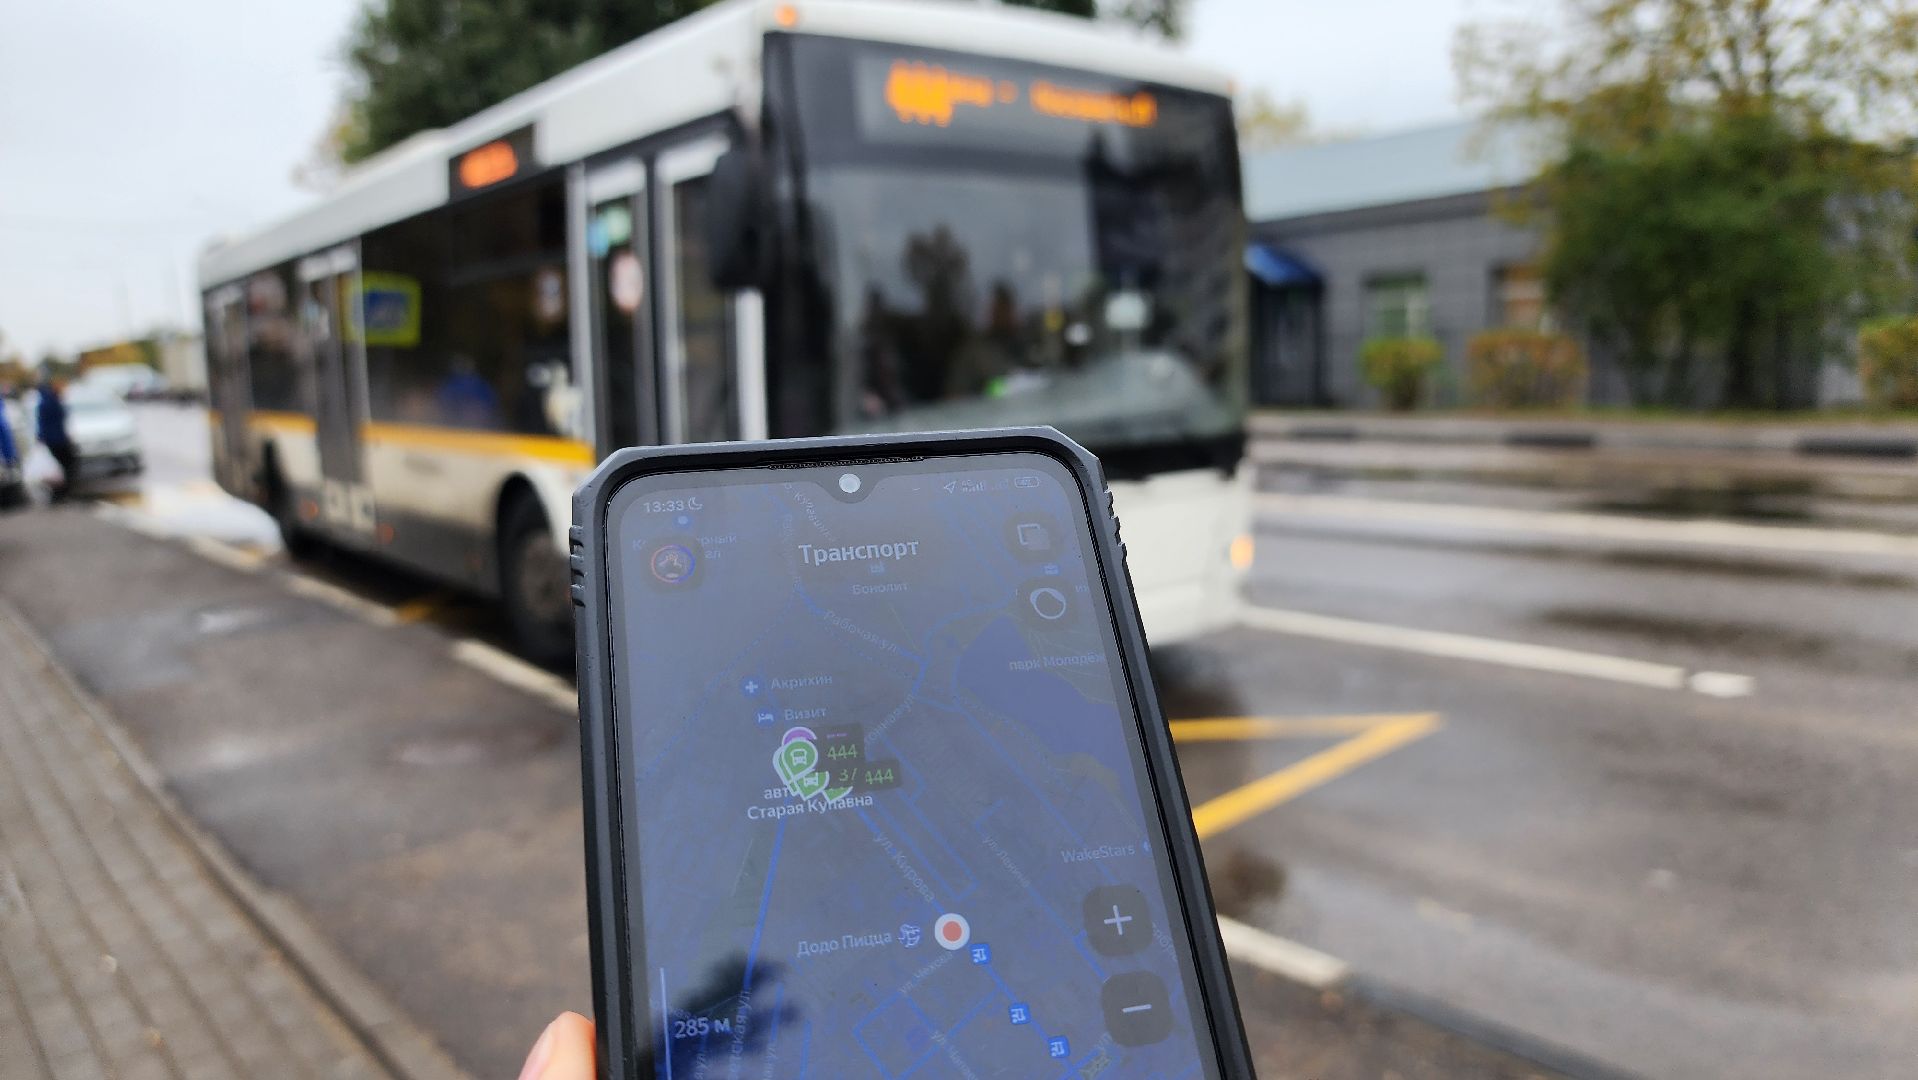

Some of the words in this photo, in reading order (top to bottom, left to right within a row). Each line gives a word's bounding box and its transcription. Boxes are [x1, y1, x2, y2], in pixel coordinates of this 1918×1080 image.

[643, 499, 685, 513] 13:33
[798, 540, 919, 567] Транспорт
[852, 582, 909, 596] Бонолит
[824, 608, 881, 646] Рабочая
[770, 674, 833, 690] Акрихин
[784, 706, 827, 721] Визит
[827, 743, 858, 760] 444
[865, 767, 894, 785] 444
[747, 800, 805, 820] Старая
[808, 793, 873, 815] Купавна
[1060, 844, 1136, 864] WakeStars
[893, 850, 936, 902] Кирова
[796, 939, 839, 958] Додо
[842, 932, 893, 951] Пицца
[674, 1016, 709, 1039] 285
[714, 1017, 730, 1033] м
